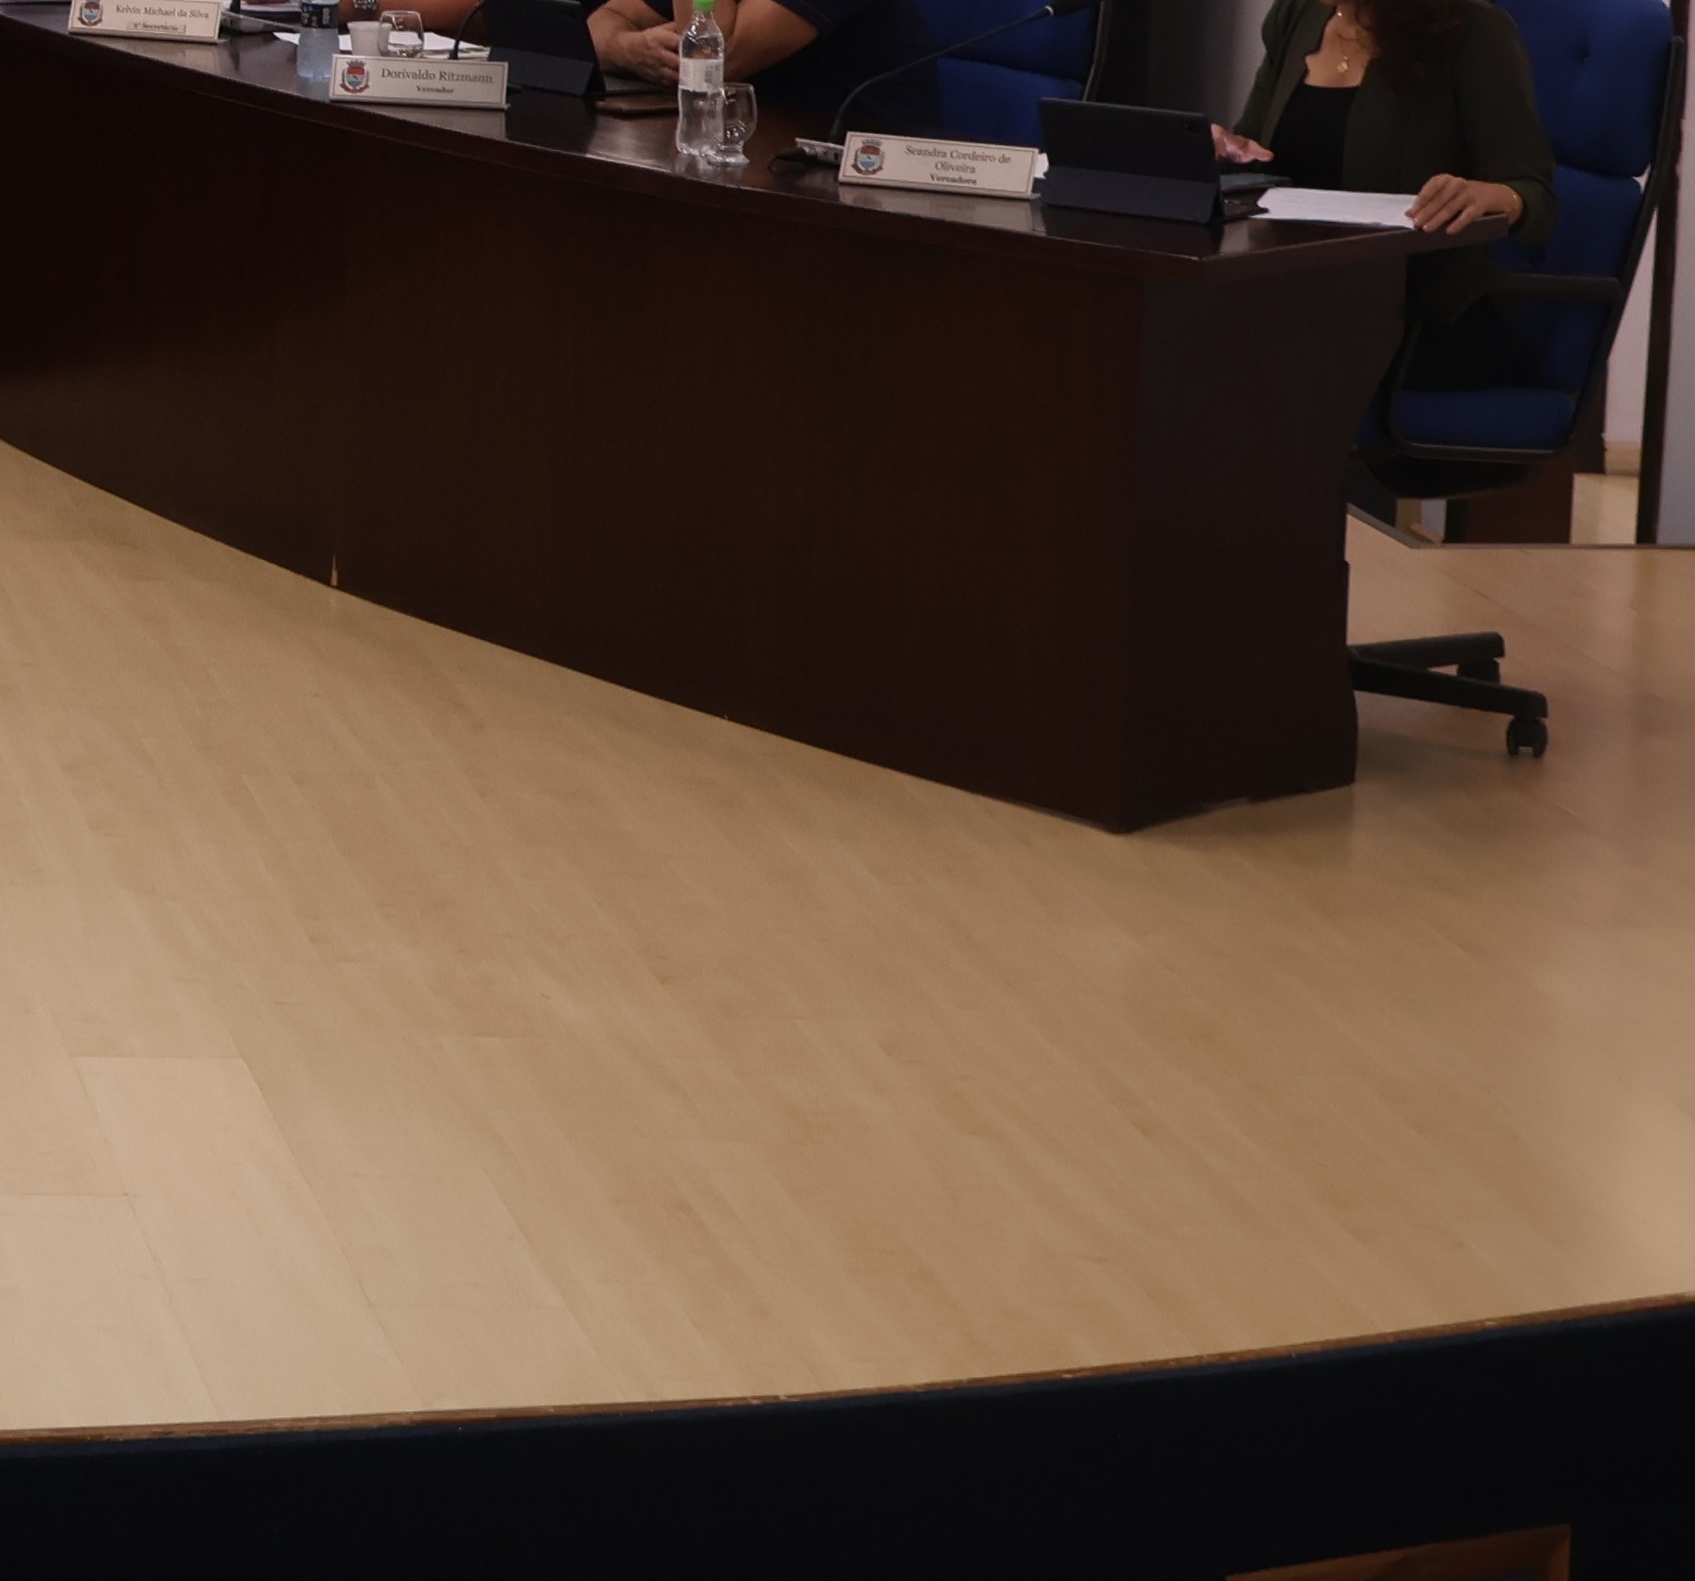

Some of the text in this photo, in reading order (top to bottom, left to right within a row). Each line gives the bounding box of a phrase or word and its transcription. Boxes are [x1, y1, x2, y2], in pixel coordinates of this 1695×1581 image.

[188, 9, 210, 20] Silva
[381, 67, 493, 84] Dorivaldo Ritzmann
